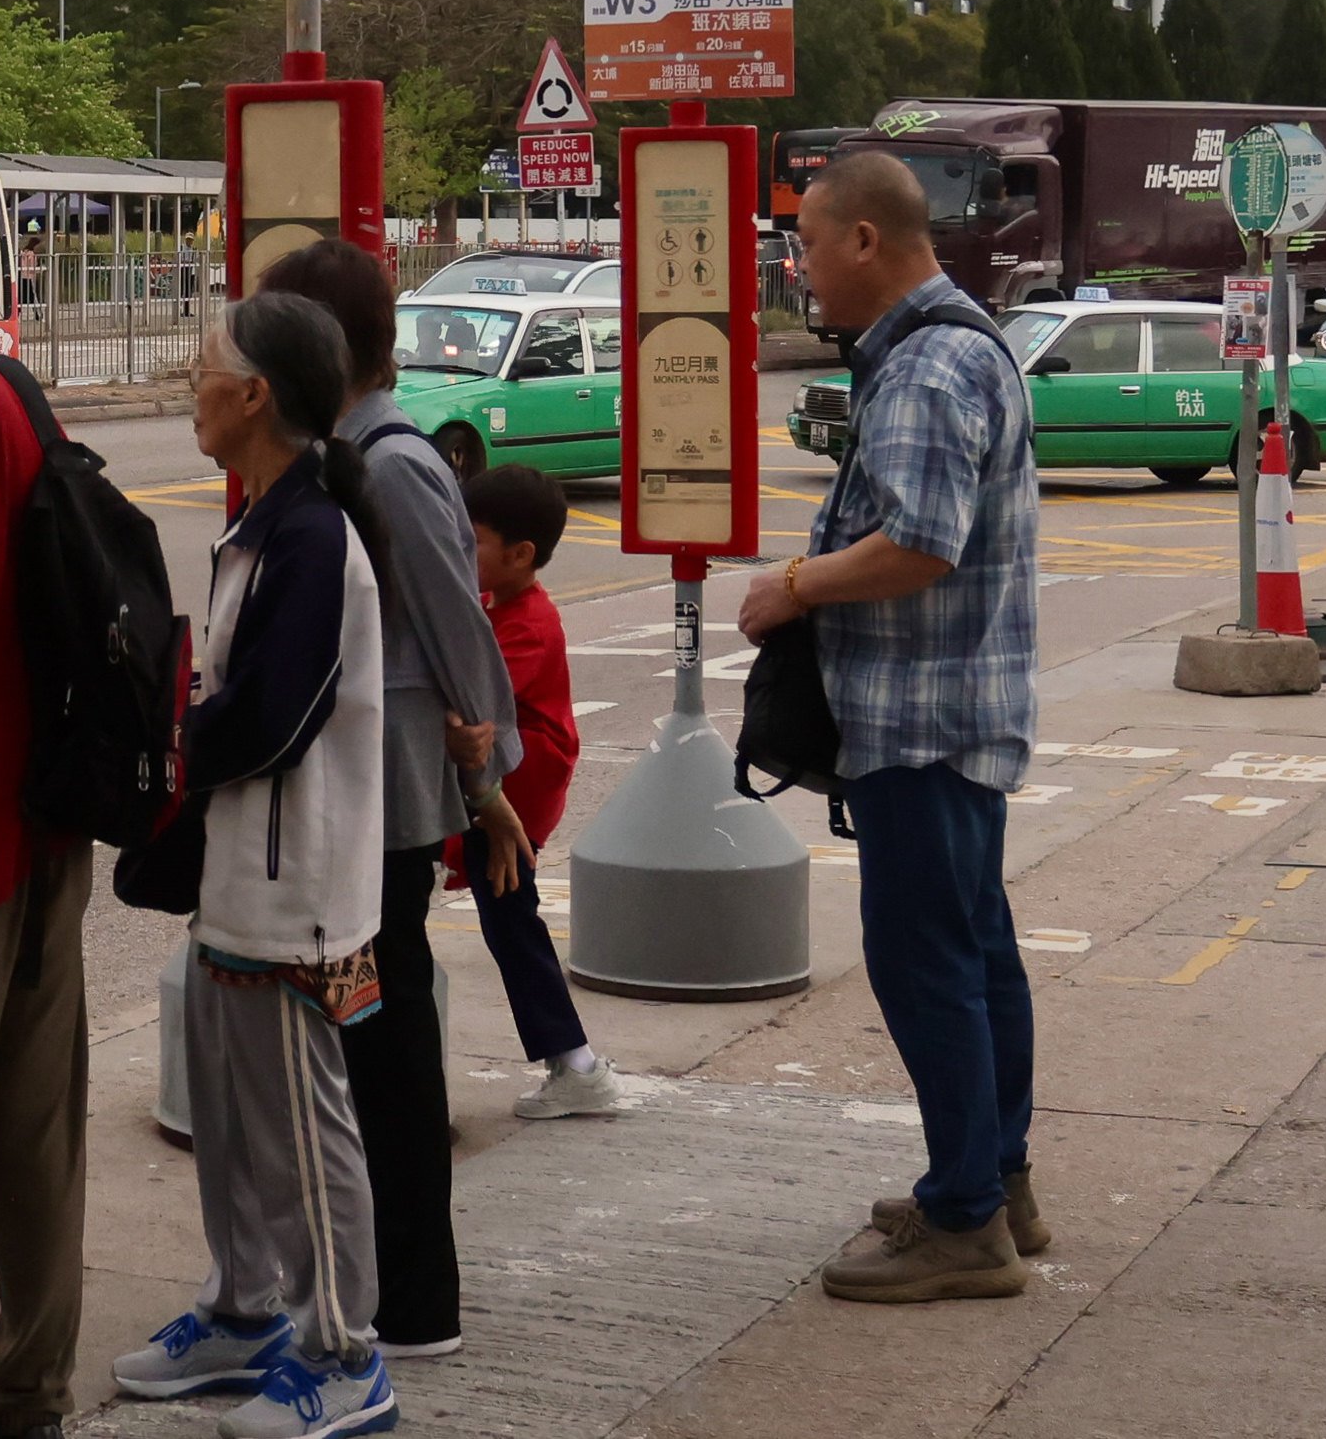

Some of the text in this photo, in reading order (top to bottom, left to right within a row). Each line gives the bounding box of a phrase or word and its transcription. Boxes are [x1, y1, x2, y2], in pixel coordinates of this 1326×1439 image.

[691, 10, 771, 32] 班次頻密
[661, 64, 700, 77] 沙田站
[737, 62, 776, 75] 大角咀
[532, 139, 579, 152] REDUCE
[522, 151, 590, 166] SPEED NOW
[526, 166, 588, 185] 開始減速
[1143, 163, 1222, 195] Hi-Speed
[475, 278, 516, 292] TAXI
[1077, 288, 1099, 300] TAXI
[654, 355, 719, 373] 九巴月票
[653, 375, 720, 385] MONTHLY PASS
[1175, 388, 1204, 403] 的士
[1175, 403, 1205, 417] TAXI
